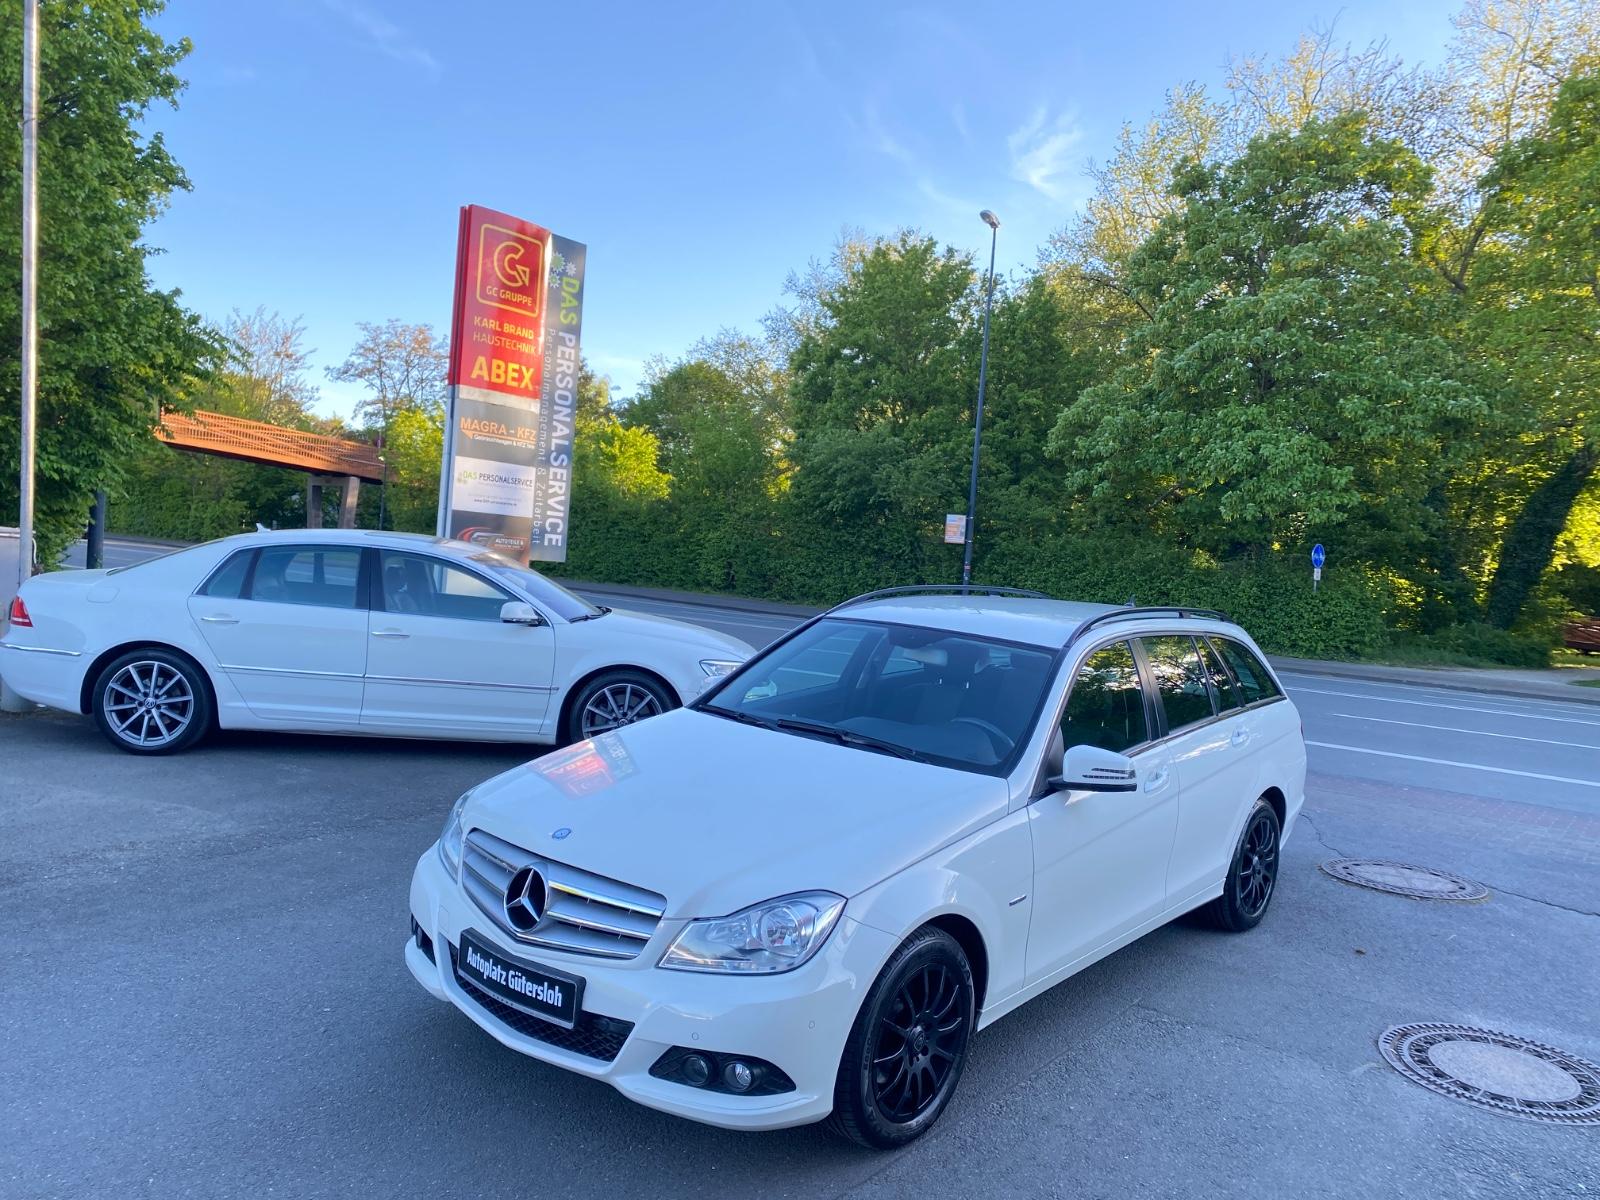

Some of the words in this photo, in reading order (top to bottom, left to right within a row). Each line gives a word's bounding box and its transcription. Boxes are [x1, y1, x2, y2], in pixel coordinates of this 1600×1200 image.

[486, 285, 498, 297] GC
[500, 290, 533, 307] GRUPPE
[559, 276, 580, 325] DAS
[473, 331, 537, 354] HAUSTECHNIK
[474, 316, 502, 332] KARL
[503, 323, 535, 339] BRAND
[470, 356, 535, 391] ABEX
[460, 416, 507, 435] MAGRA
[517, 427, 537, 441] KFZ
[544, 331, 576, 547] PERSONALSERVICE
[466, 946, 507, 985] Autoplatz
[508, 970, 562, 1008] Gütersloh
